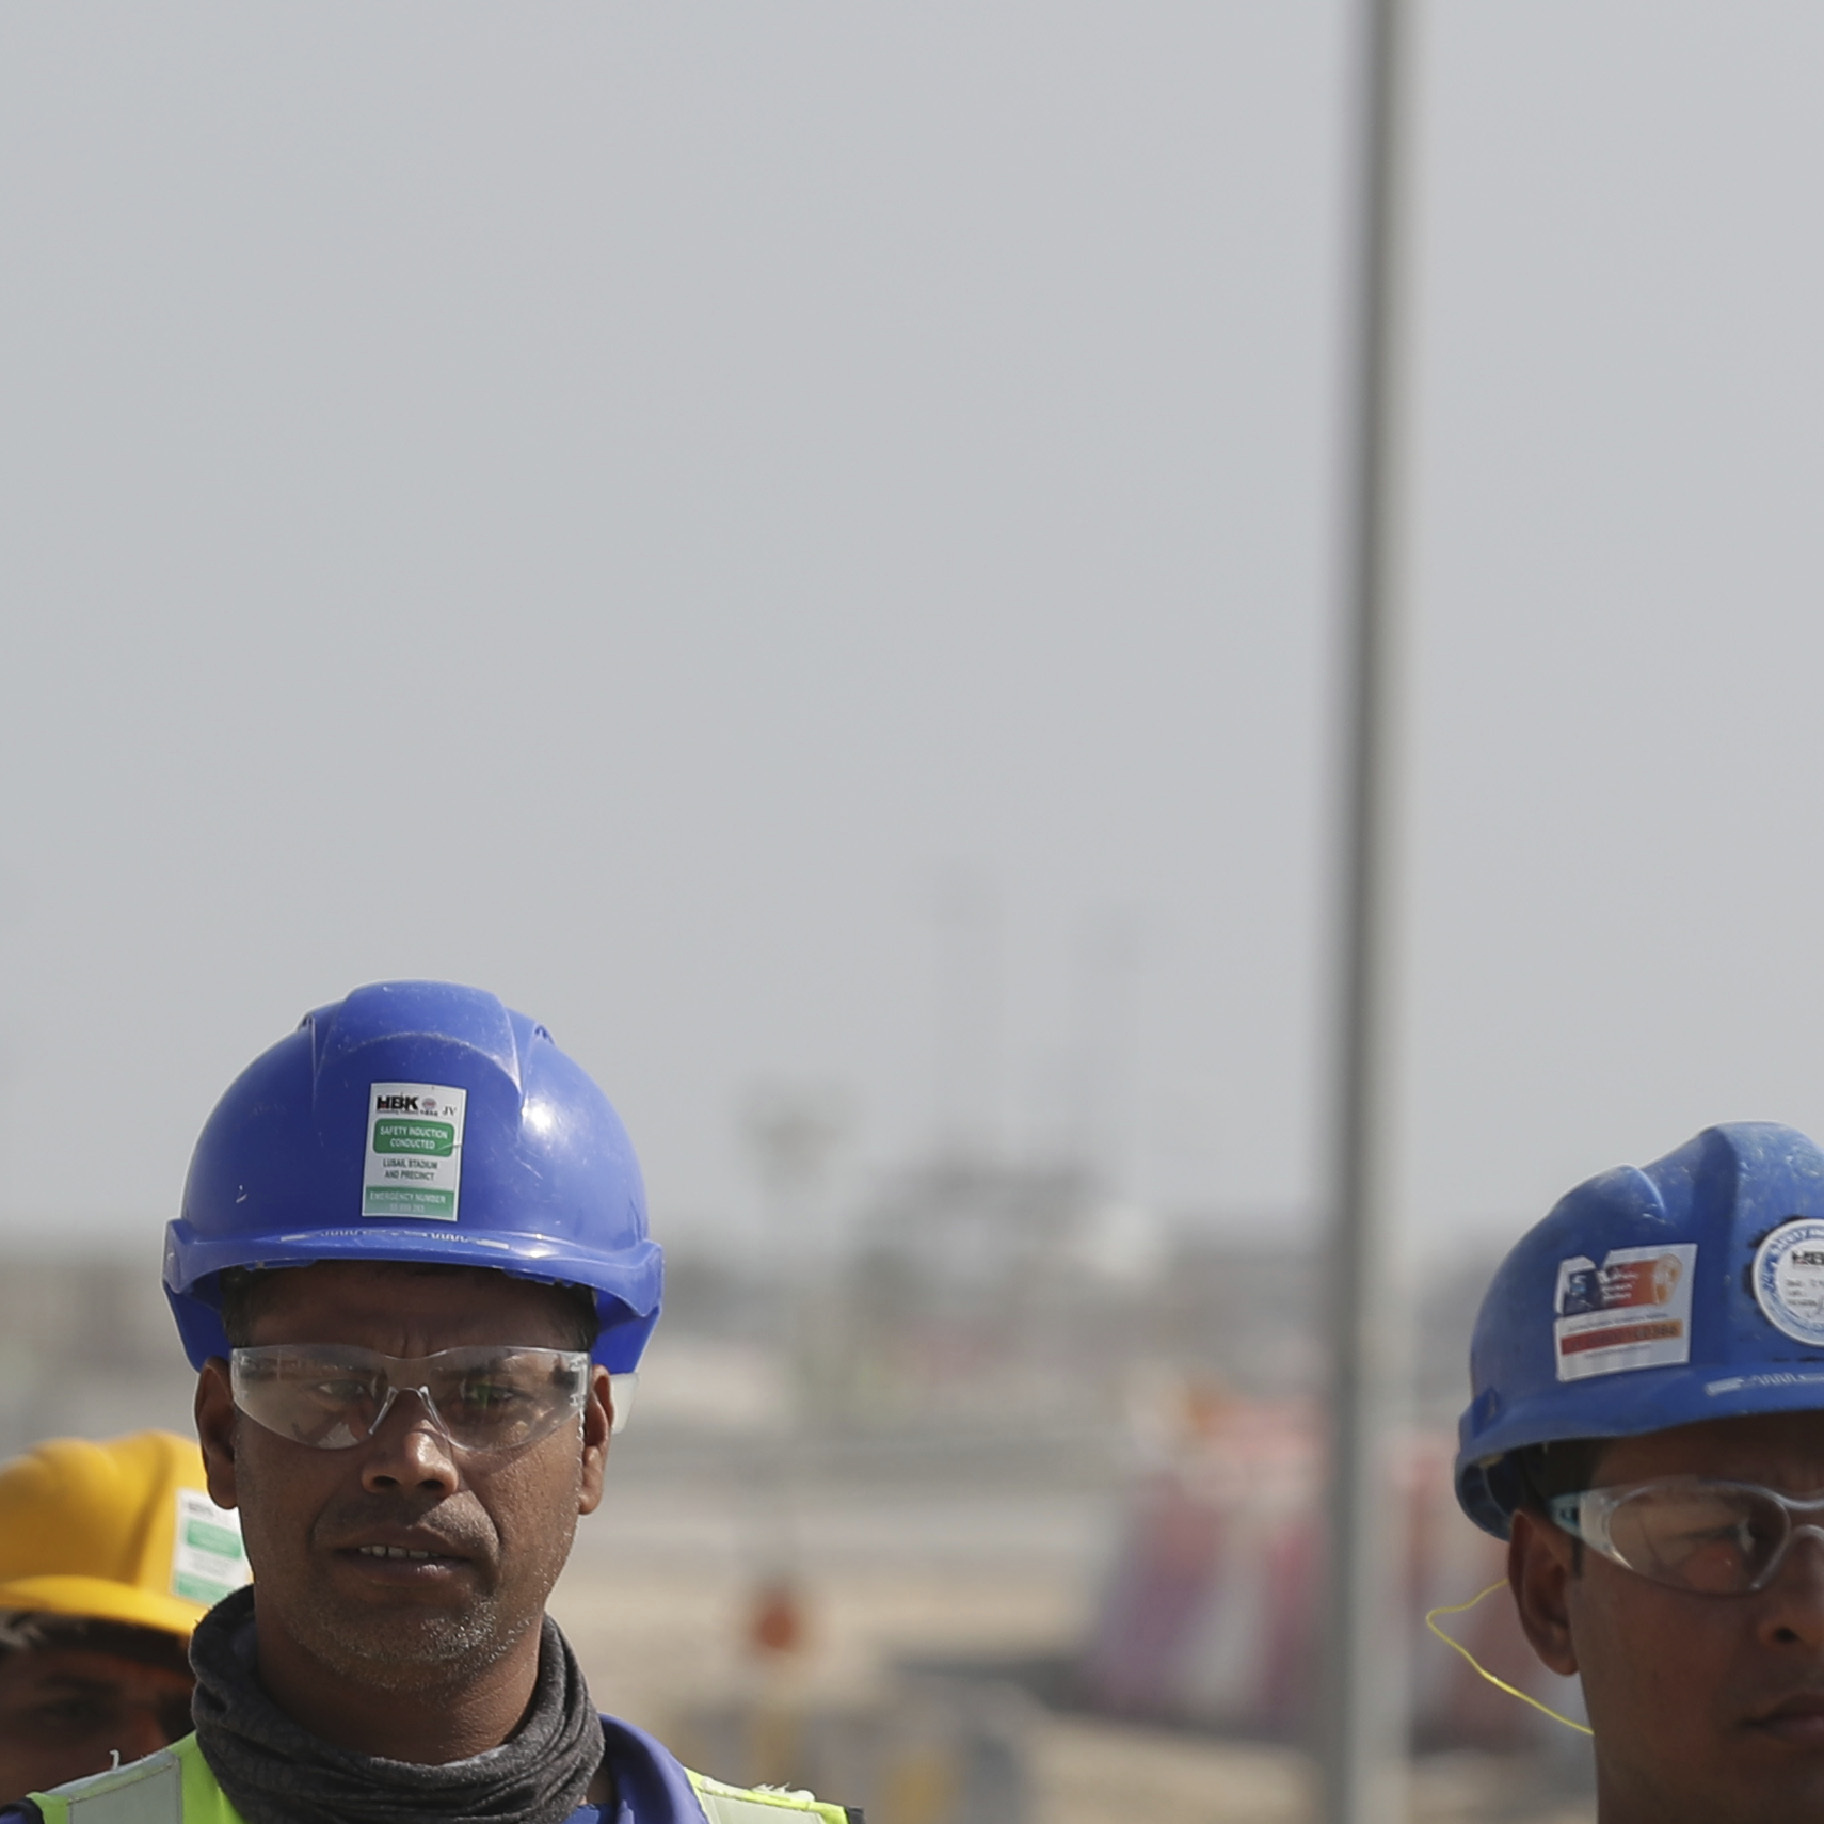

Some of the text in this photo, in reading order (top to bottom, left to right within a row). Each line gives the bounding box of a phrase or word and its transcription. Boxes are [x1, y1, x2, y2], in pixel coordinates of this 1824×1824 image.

[377, 1095, 418, 1110] HBK
[380, 1125, 448, 1139] SAFETY INDUCTION
[389, 1138, 435, 1149] CONDUCTED
[408, 1158, 437, 1169] STADIUM
[384, 1169, 434, 1181] AND PRECINCT
[369, 1190, 446, 1204] EMERGENCY NUMBER
